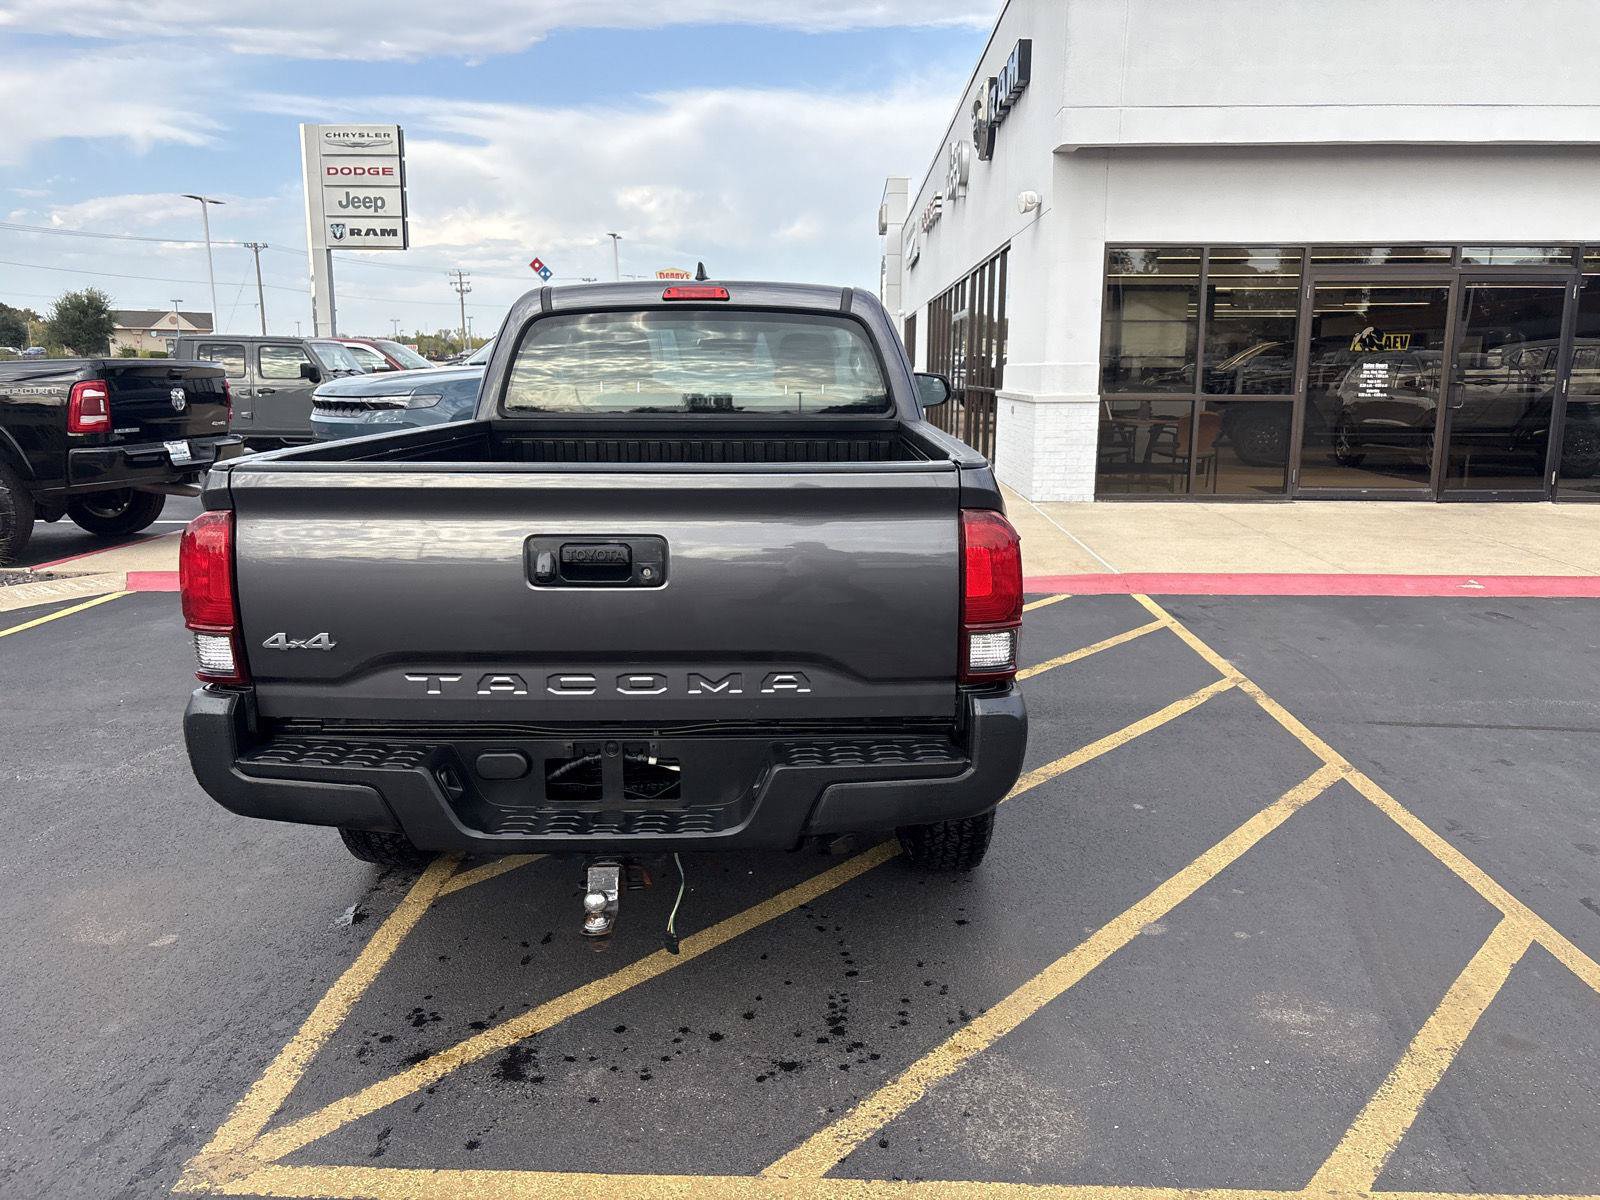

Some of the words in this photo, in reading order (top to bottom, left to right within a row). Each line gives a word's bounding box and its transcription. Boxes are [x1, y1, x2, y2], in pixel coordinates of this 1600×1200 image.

[326, 166, 394, 176] DODGE
[338, 191, 386, 213] Jeep
[349, 228, 398, 237] RAM
[1383, 334, 1409, 350] AEV
[566, 549, 625, 561] TOYOTA
[262, 632, 337, 650] 4x4
[404, 672, 812, 695] TACOMA
